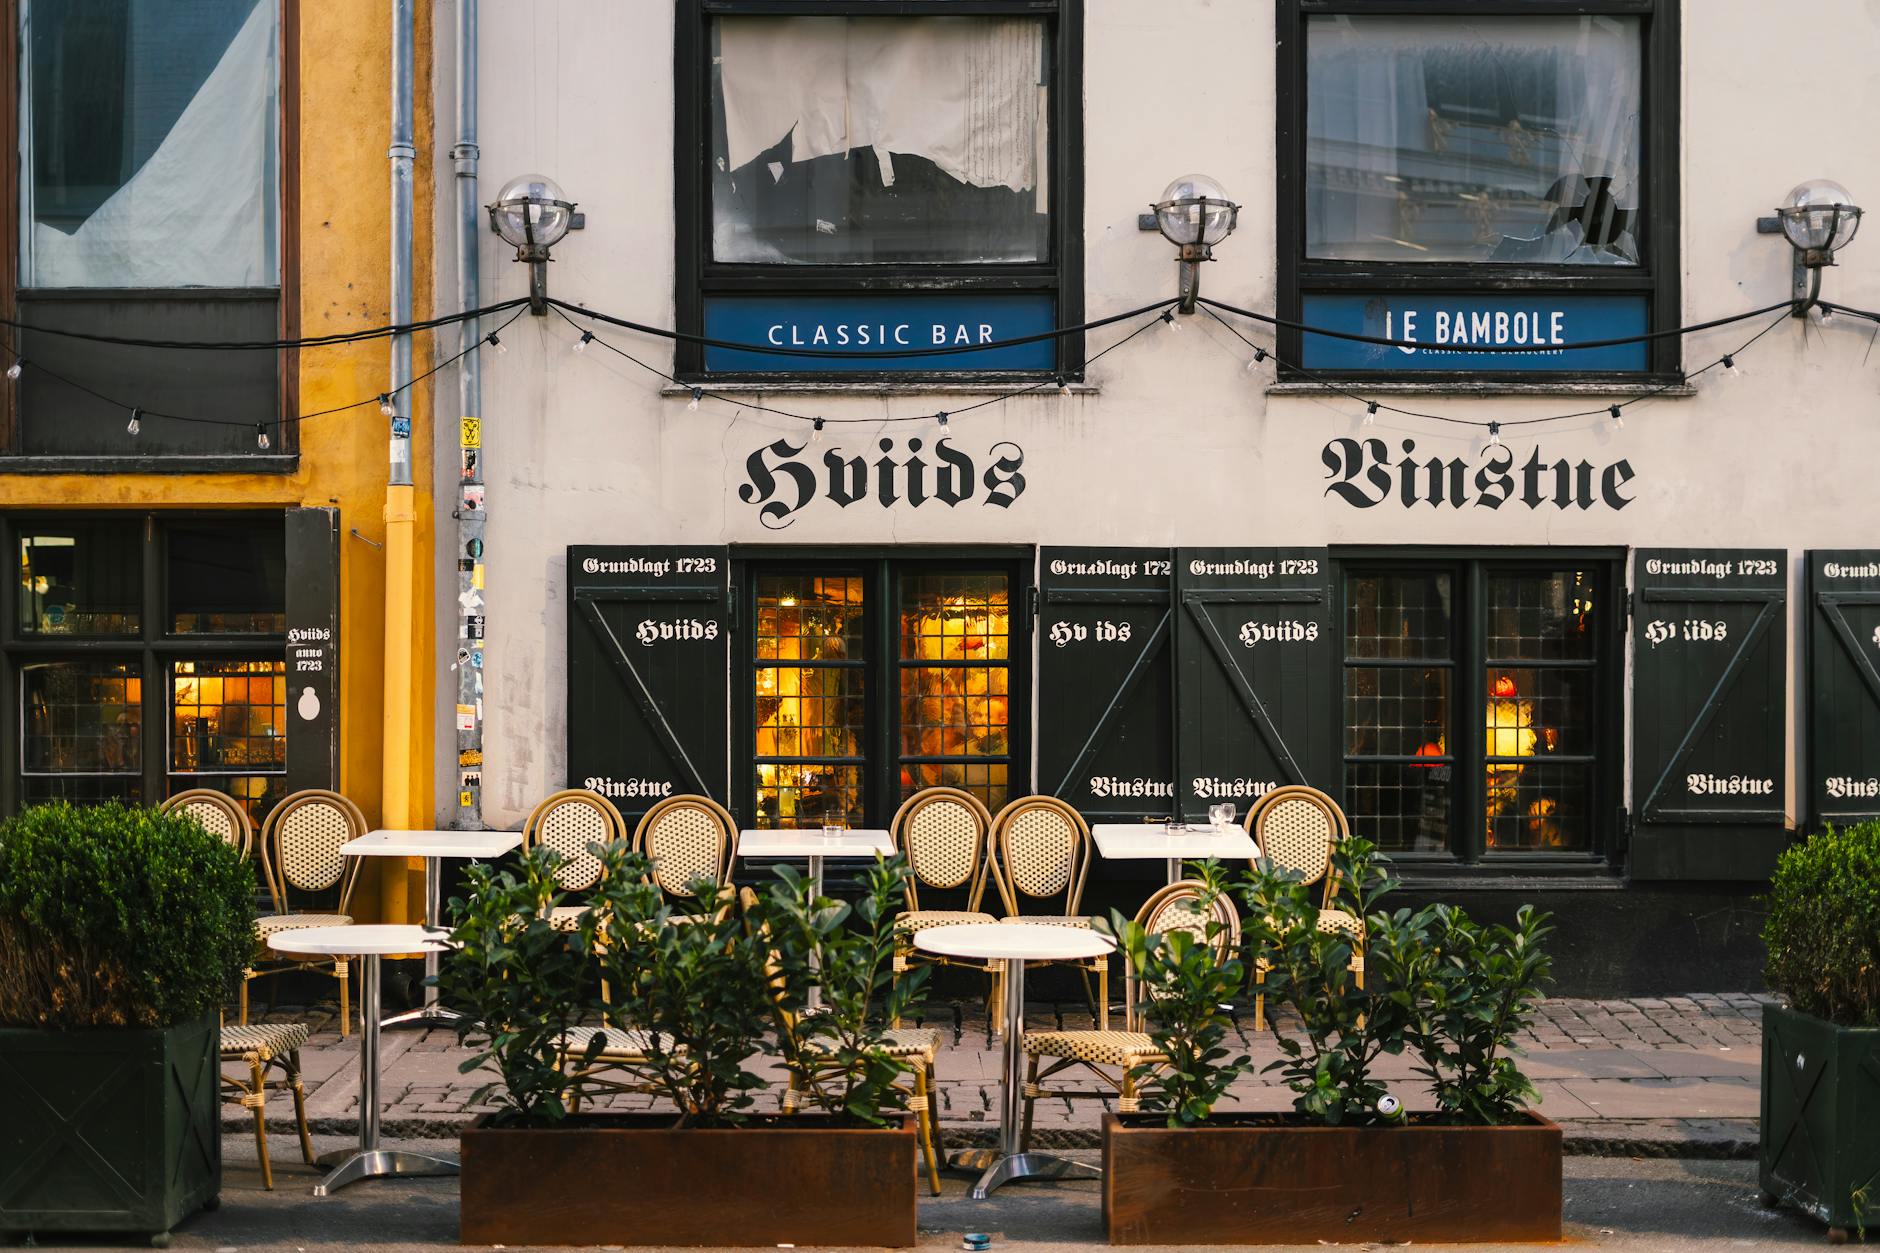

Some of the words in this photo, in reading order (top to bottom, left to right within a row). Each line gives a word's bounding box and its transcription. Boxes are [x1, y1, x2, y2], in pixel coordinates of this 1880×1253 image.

[769, 325, 909, 345] CLASSIC
[933, 325, 992, 344] BAR
[1436, 311, 1564, 344] BAMBOLE
[739, 438, 1025, 529] Hviids
[1322, 438, 1637, 511] Vinstue
[583, 558, 670, 577] Grundlagt
[676, 558, 716, 572] 1723
[1190, 560, 1274, 579] Grundlagt
[1279, 560, 1318, 574] 1723
[1646, 559, 1732, 578] Grundlagt
[1738, 560, 1777, 575] 1723
[1824, 563, 1880, 577] Grund
[288, 628, 331, 643] Hviids
[636, 619, 718, 646] Hviids
[1239, 621, 1318, 648] Hviids
[296, 649, 323, 658] anno
[296, 660, 323, 672] 1723
[1687, 774, 1773, 794] Vinstue
[1826, 777, 1880, 797] Vins
